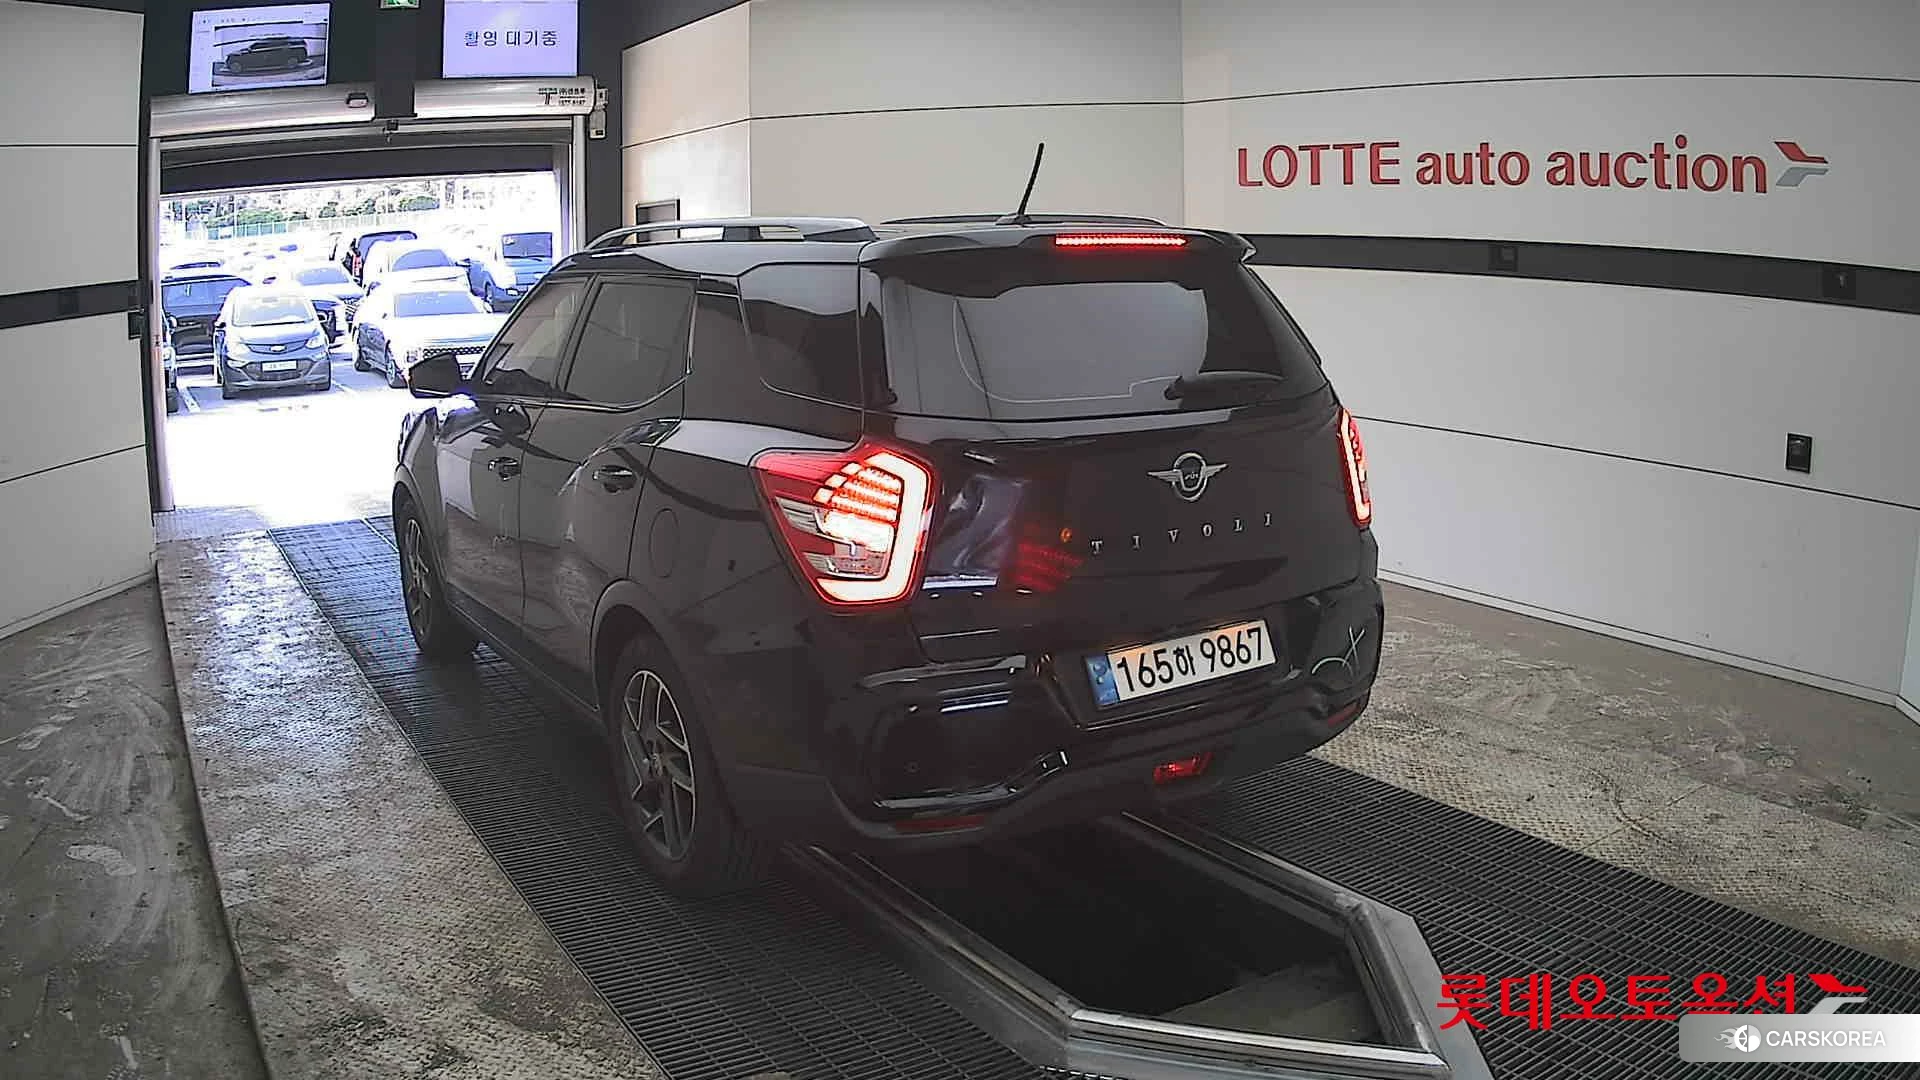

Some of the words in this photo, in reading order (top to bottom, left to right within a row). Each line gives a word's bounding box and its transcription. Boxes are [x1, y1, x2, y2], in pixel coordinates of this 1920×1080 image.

[506, 30, 558, 47] 대기중
[1237, 141, 1400, 188] LOTTE
[1416, 141, 1530, 187] auto
[1546, 134, 1768, 194] auction
[1091, 512, 1273, 555] TIVOLI
[1117, 645, 1197, 692] 165하
[1200, 627, 1262, 673] 9867
